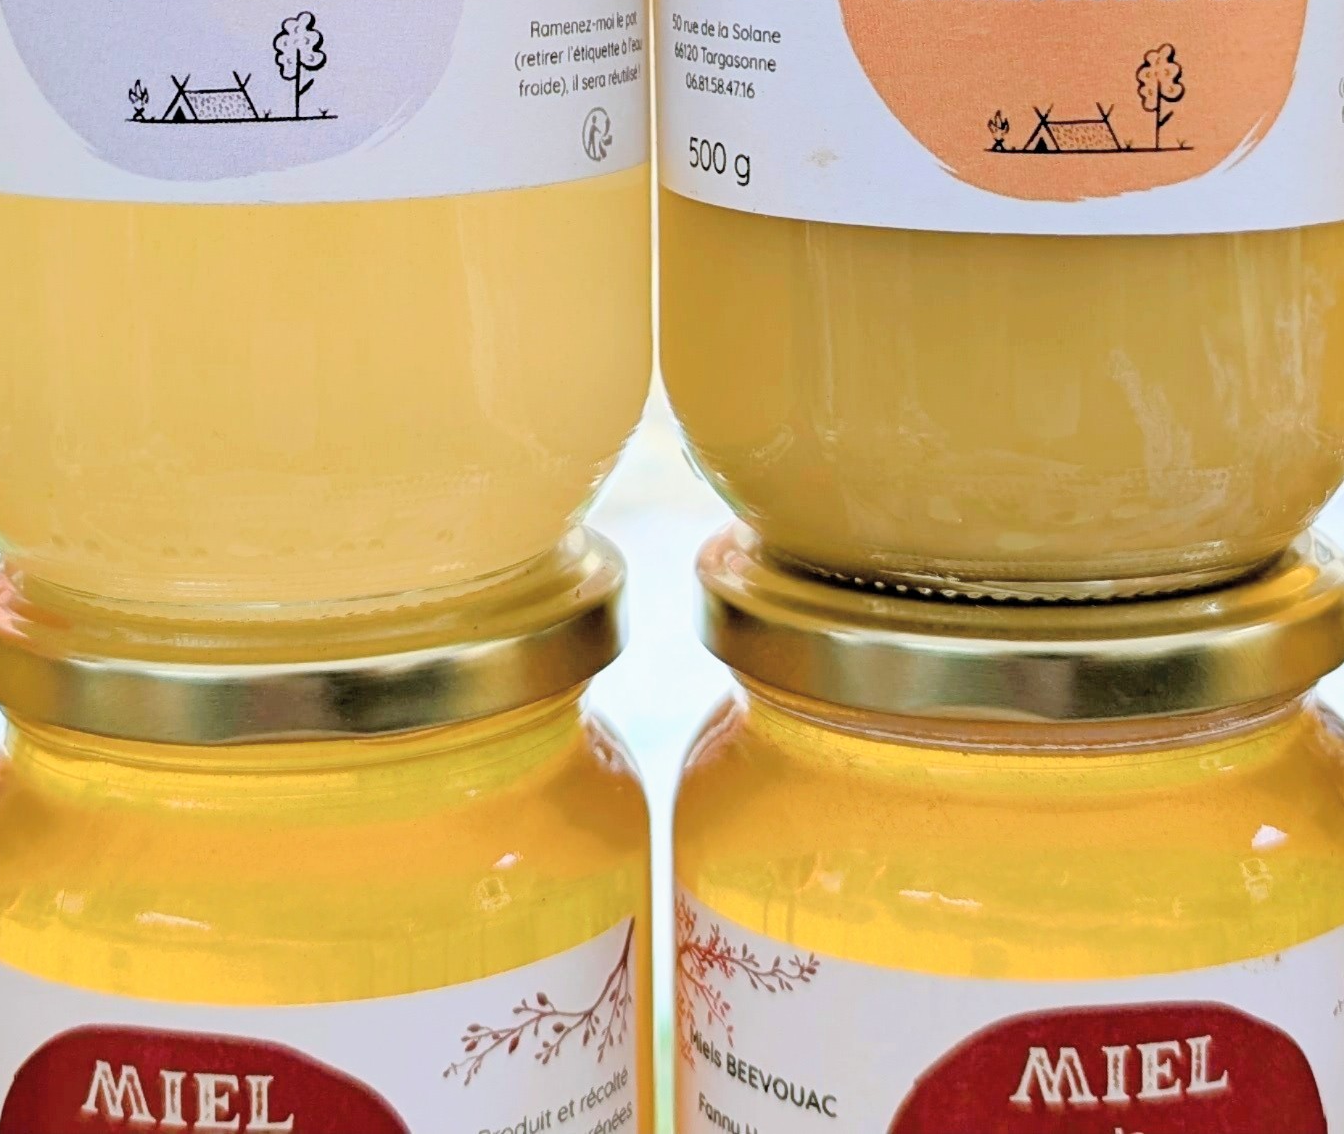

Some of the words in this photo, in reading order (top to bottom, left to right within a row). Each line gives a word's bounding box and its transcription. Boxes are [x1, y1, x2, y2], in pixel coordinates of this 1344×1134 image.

[530, 13, 614, 38] Ramenez-moi
[616, 12, 624, 28] le
[672, 13, 682, 31] 50
[683, 20, 699, 35] rue
[701, 18, 715, 37] de
[718, 21, 729, 39] la
[732, 23, 781, 44] Solane
[514, 49, 564, 71] (retirer
[567, 42, 619, 64] l'étiquette
[674, 41, 698, 62] 66120
[701, 46, 777, 72] Targasonne
[519, 77, 569, 97] froide),
[572, 74, 579, 91] il
[582, 75, 606, 91] sera
[689, 136, 727, 174] 500
[734, 153, 751, 186] g
[690, 1023, 722, 1069] Miels
[726, 1052, 837, 1118] BEEVOUAC
[1009, 1035, 1229, 1104] MIEL
[81, 1060, 294, 1131] MIEL
[557, 1100, 575, 1123] et
[580, 1065, 628, 1112] récolté
